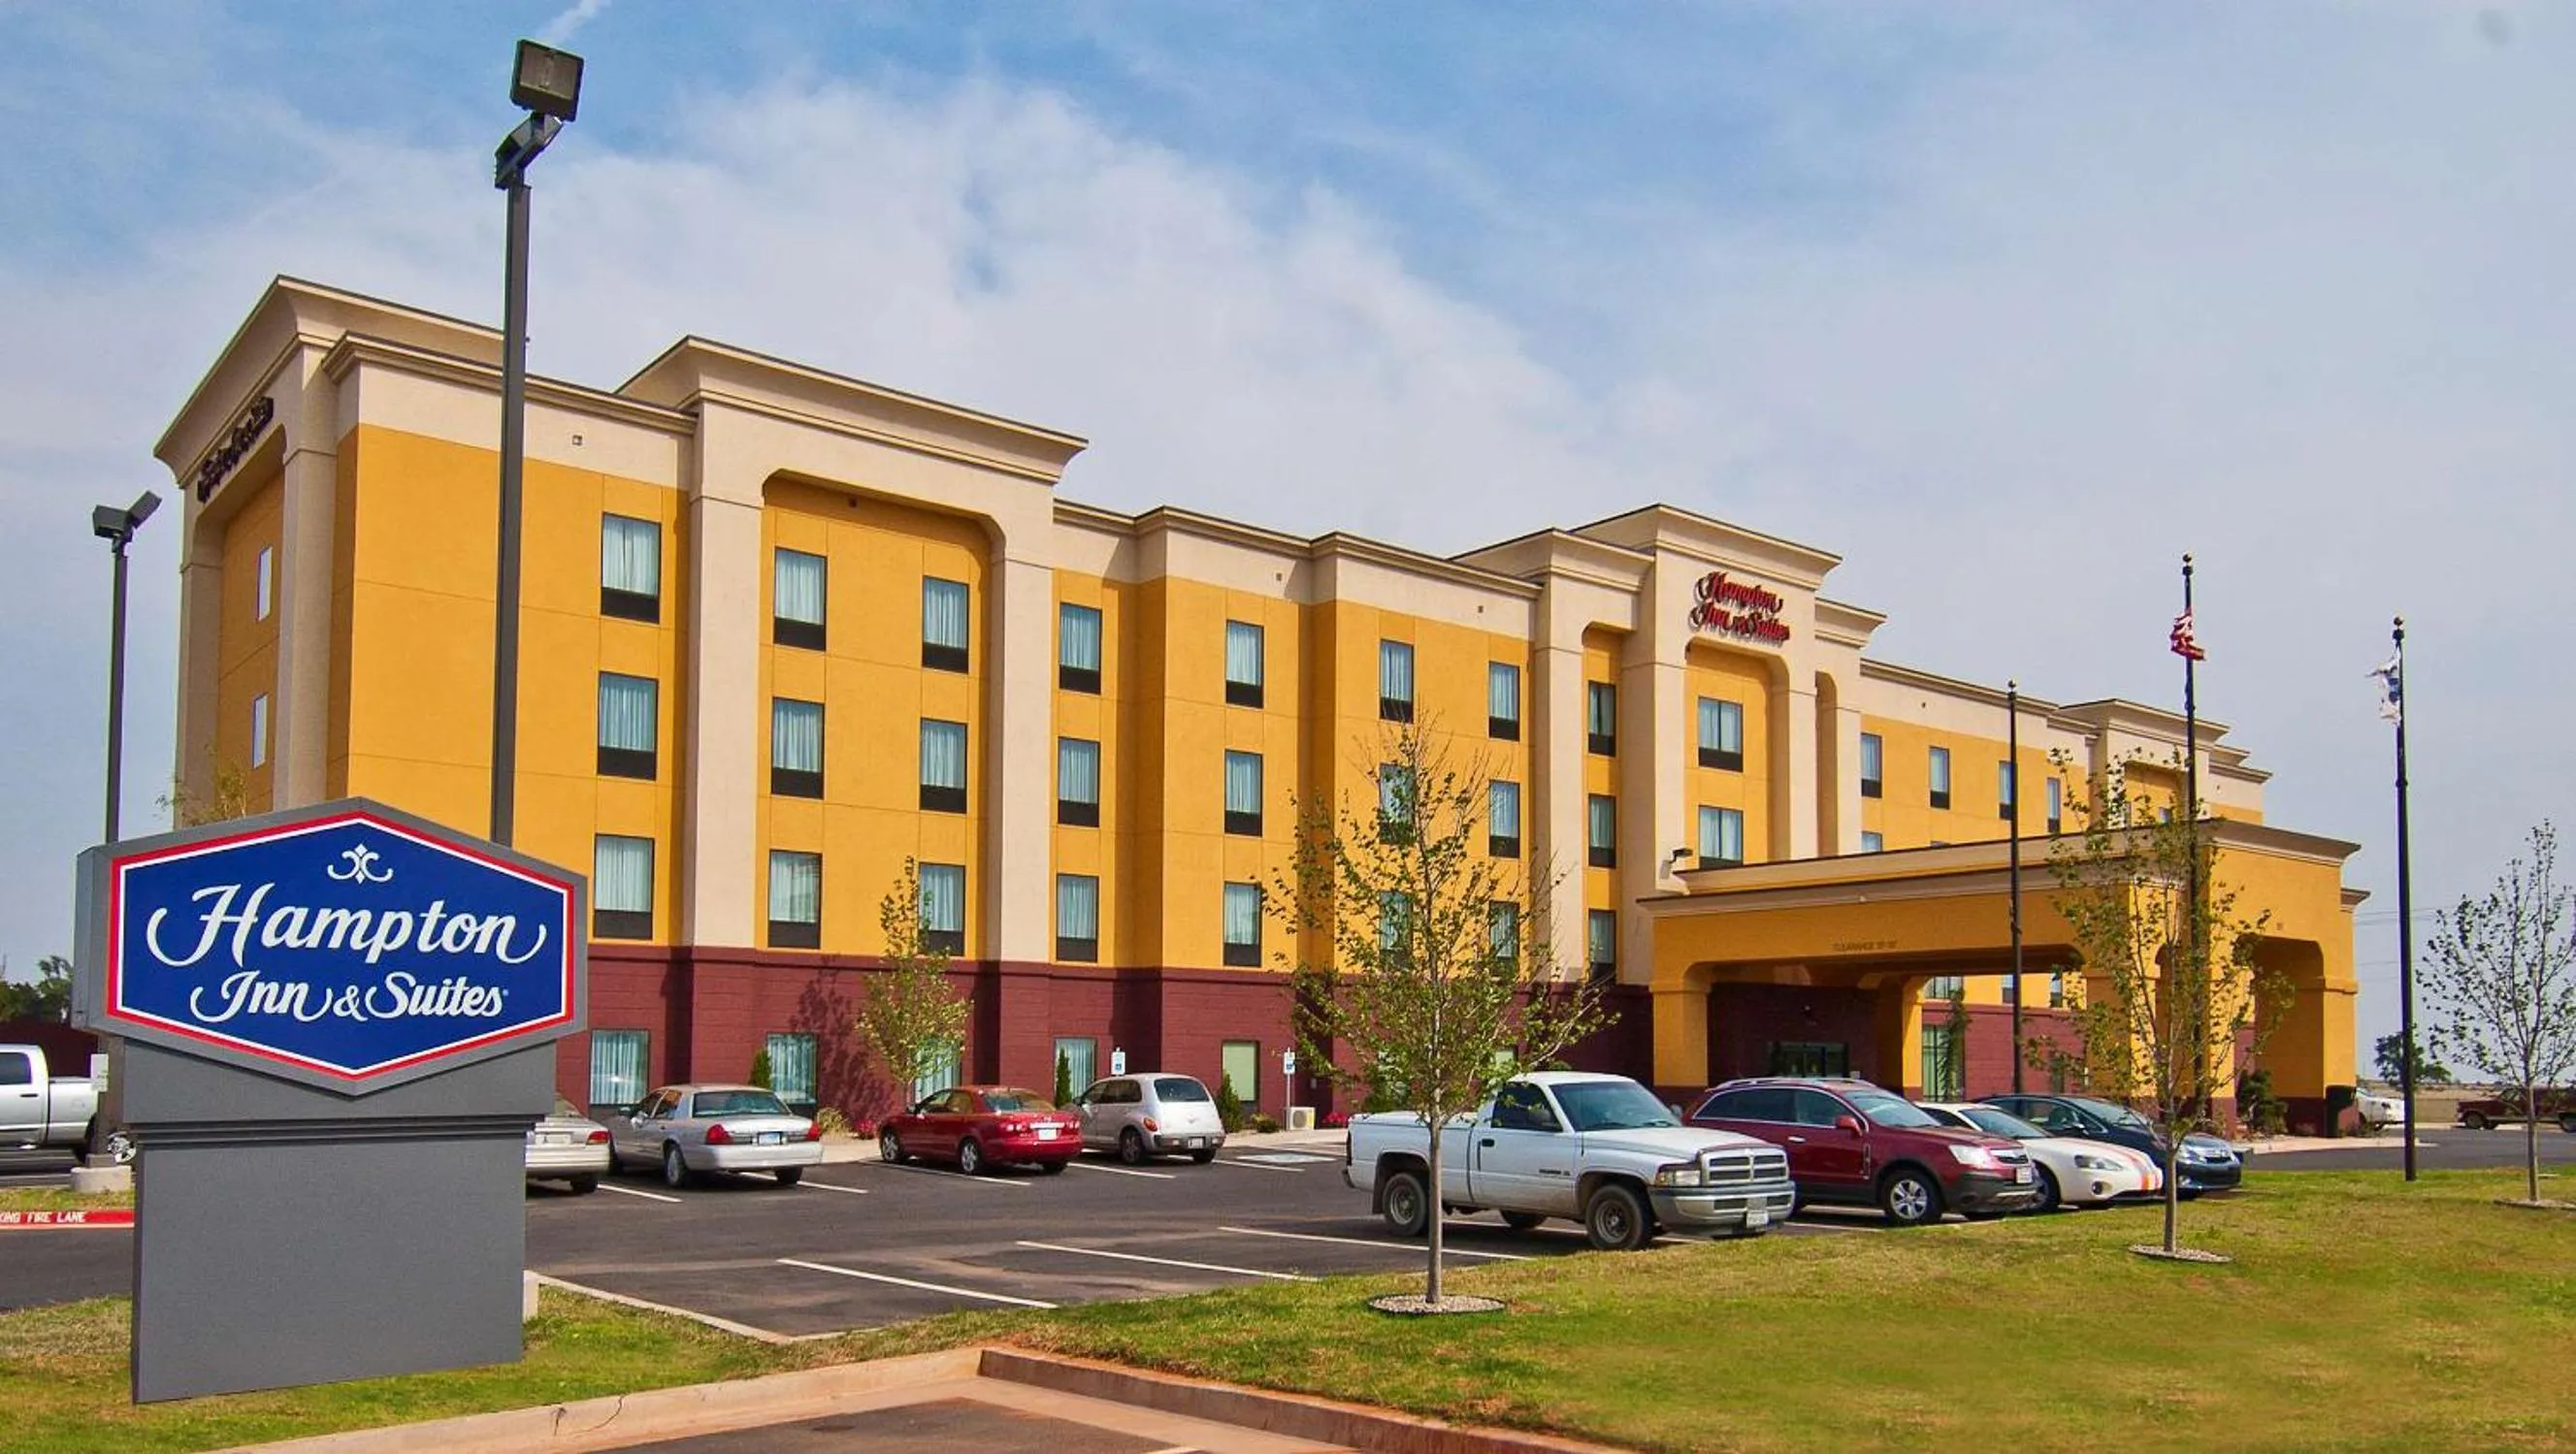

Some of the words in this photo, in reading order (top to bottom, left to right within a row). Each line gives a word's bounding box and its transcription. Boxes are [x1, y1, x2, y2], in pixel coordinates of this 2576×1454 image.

[1696, 570, 1784, 614] Hampton
[147, 882, 547, 967] Hampton
[190, 970, 333, 1023] Inn
[333, 985, 368, 1022] &
[365, 972, 504, 1019] Suites
[26, 1211, 51, 1223] FIRE
[56, 1211, 86, 1223] LANE
